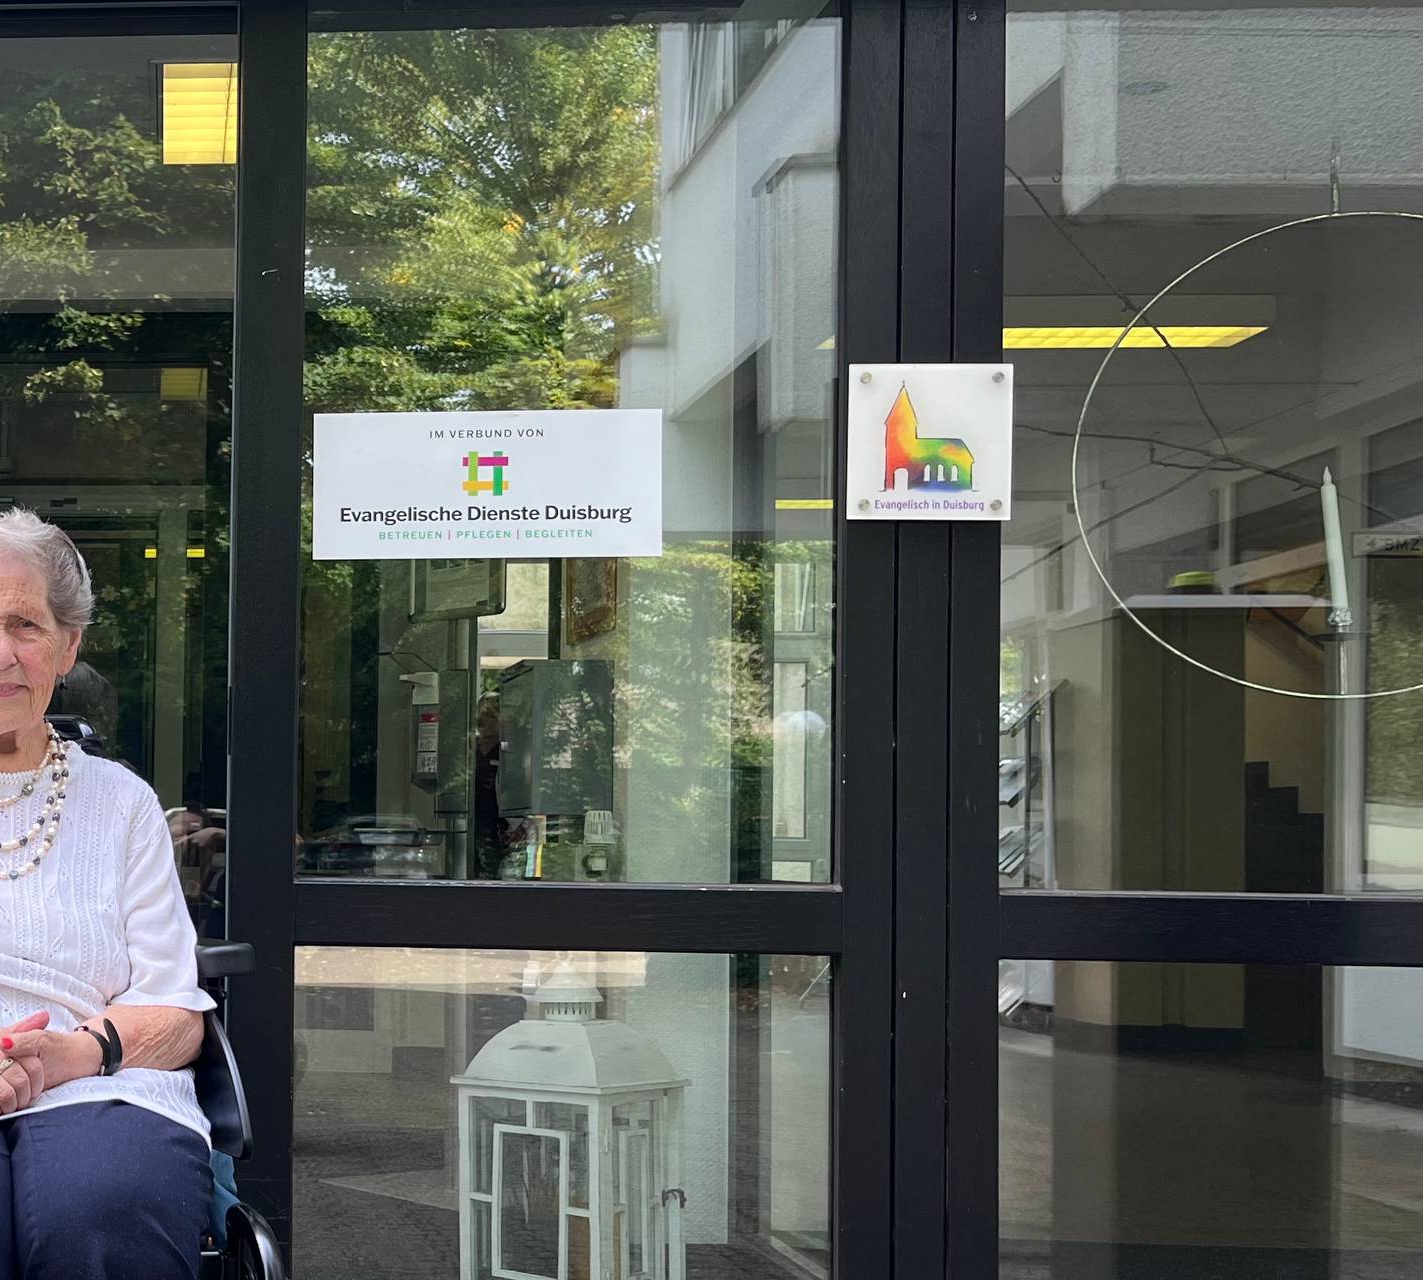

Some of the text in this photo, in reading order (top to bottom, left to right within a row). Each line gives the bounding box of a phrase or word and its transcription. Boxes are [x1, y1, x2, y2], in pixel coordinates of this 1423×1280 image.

[429, 429, 544, 439] IM VERBUND VON
[874, 500, 985, 512] Evangelisch in Duisburg
[340, 505, 632, 525] Evangelische Dienste Duisburg
[379, 529, 593, 540] BETREUEN PFLEGEN BEGLEITEN
